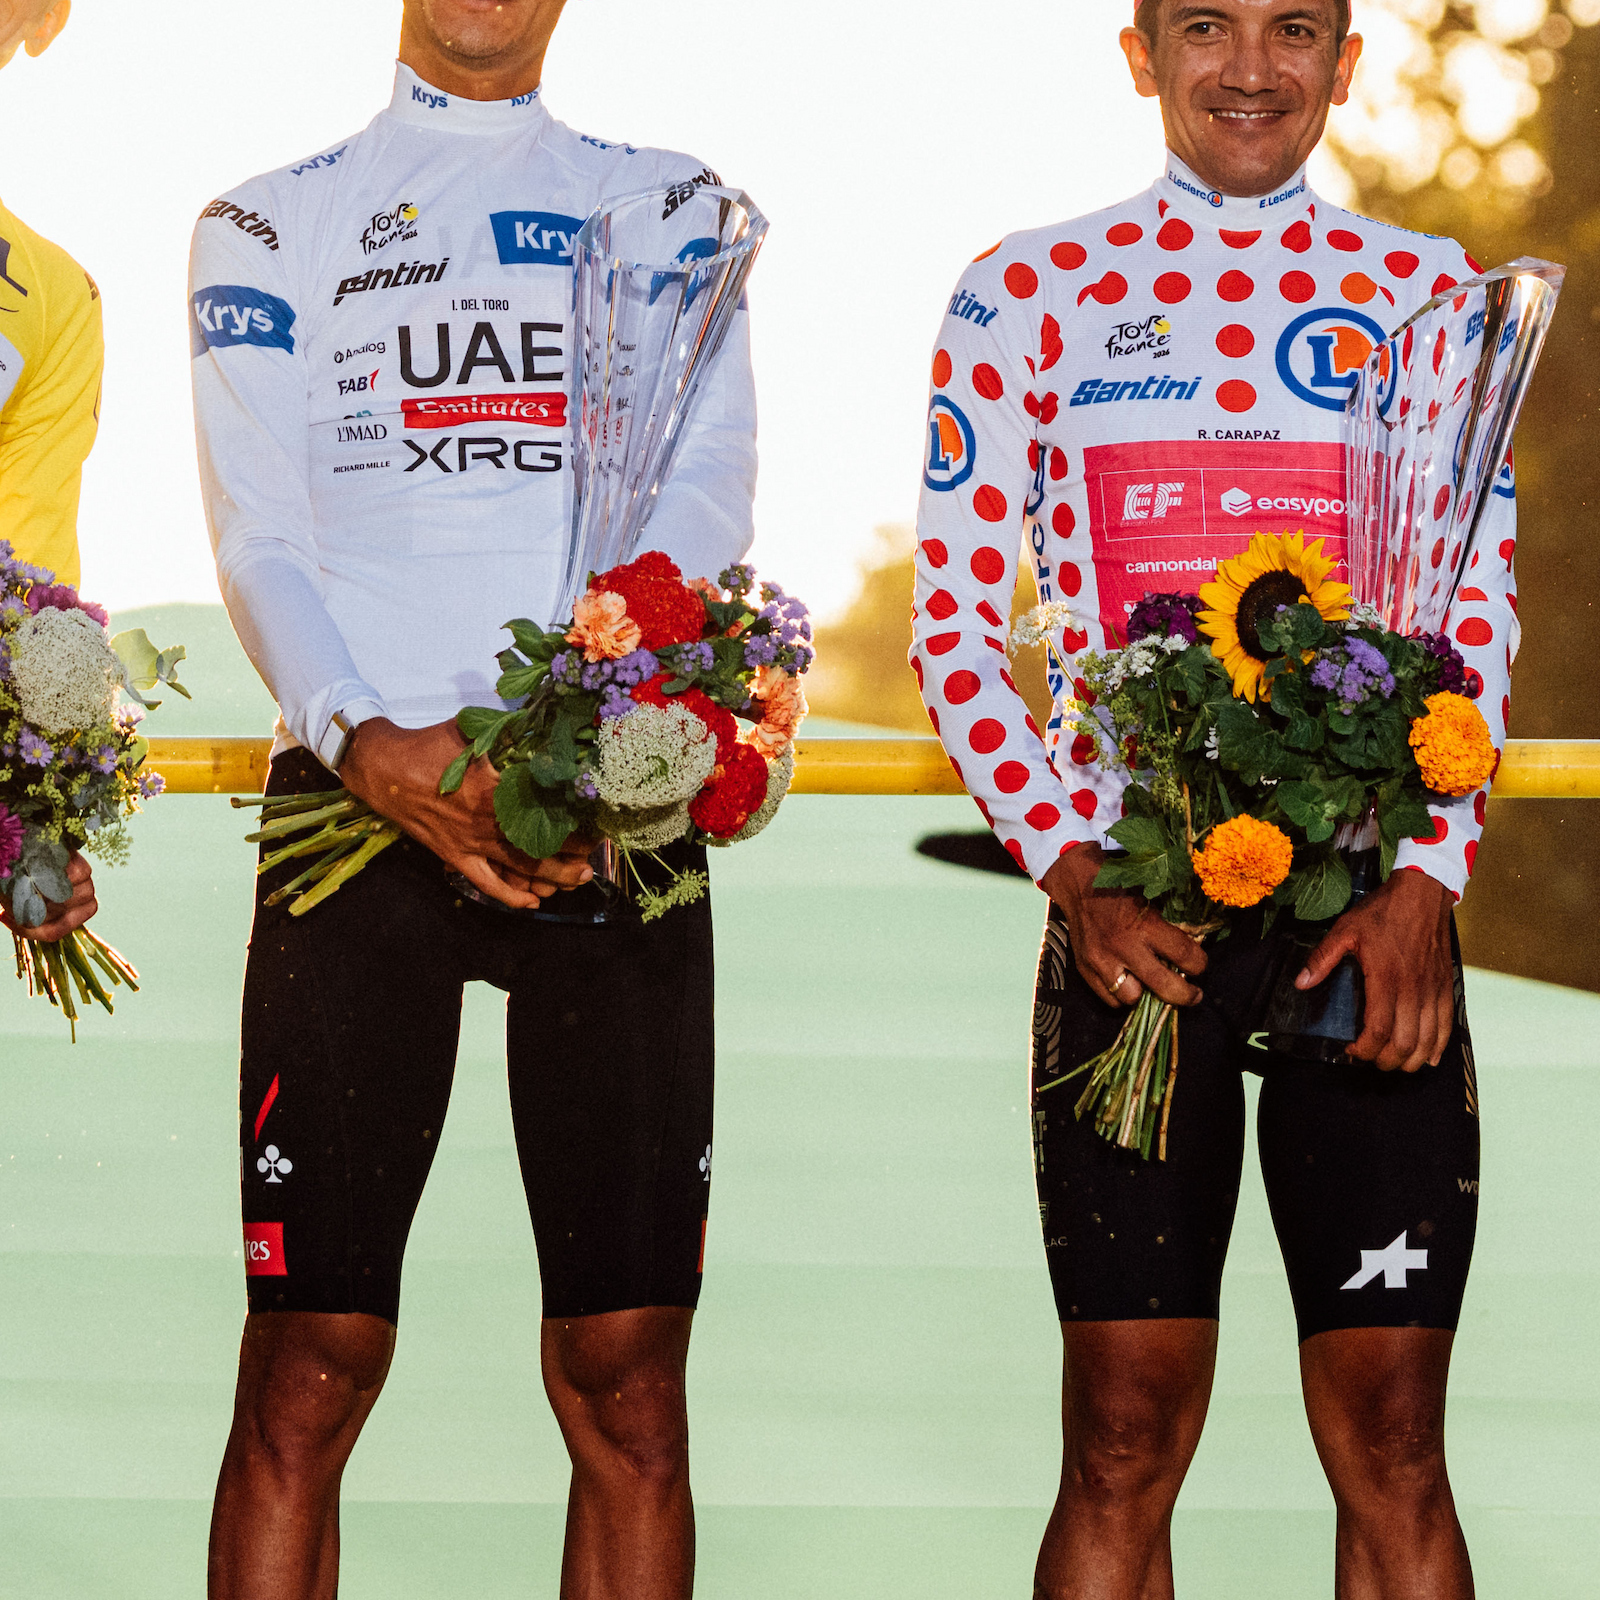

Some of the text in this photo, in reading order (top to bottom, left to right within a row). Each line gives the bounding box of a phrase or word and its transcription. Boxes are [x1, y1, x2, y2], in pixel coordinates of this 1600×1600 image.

[412, 85, 448, 109] Krys
[1168, 170, 1207, 200] E.Leclerc
[1259, 185, 1299, 208] E.Leclerc
[197, 199, 279, 251] antin
[370, 202, 413, 235] TOUR
[401, 229, 418, 241] 2026
[515, 221, 575, 257] Kry
[195, 299, 274, 335] Krys
[452, 299, 509, 311] I. DEL TORO
[1111, 314, 1165, 342] TOUR
[345, 341, 386, 360] Analog
[398, 322, 564, 388] UAE
[1153, 348, 1170, 359] 2026
[337, 377, 368, 395] FAB
[1069, 375, 1202, 407] Santini
[1198, 429, 1281, 440] R. CARAPAZ
[333, 461, 390, 473] RICHARD MILLE
[402, 437, 562, 473] XRG
[1122, 483, 1185, 520] EF
[1126, 557, 1224, 574] cannondal
